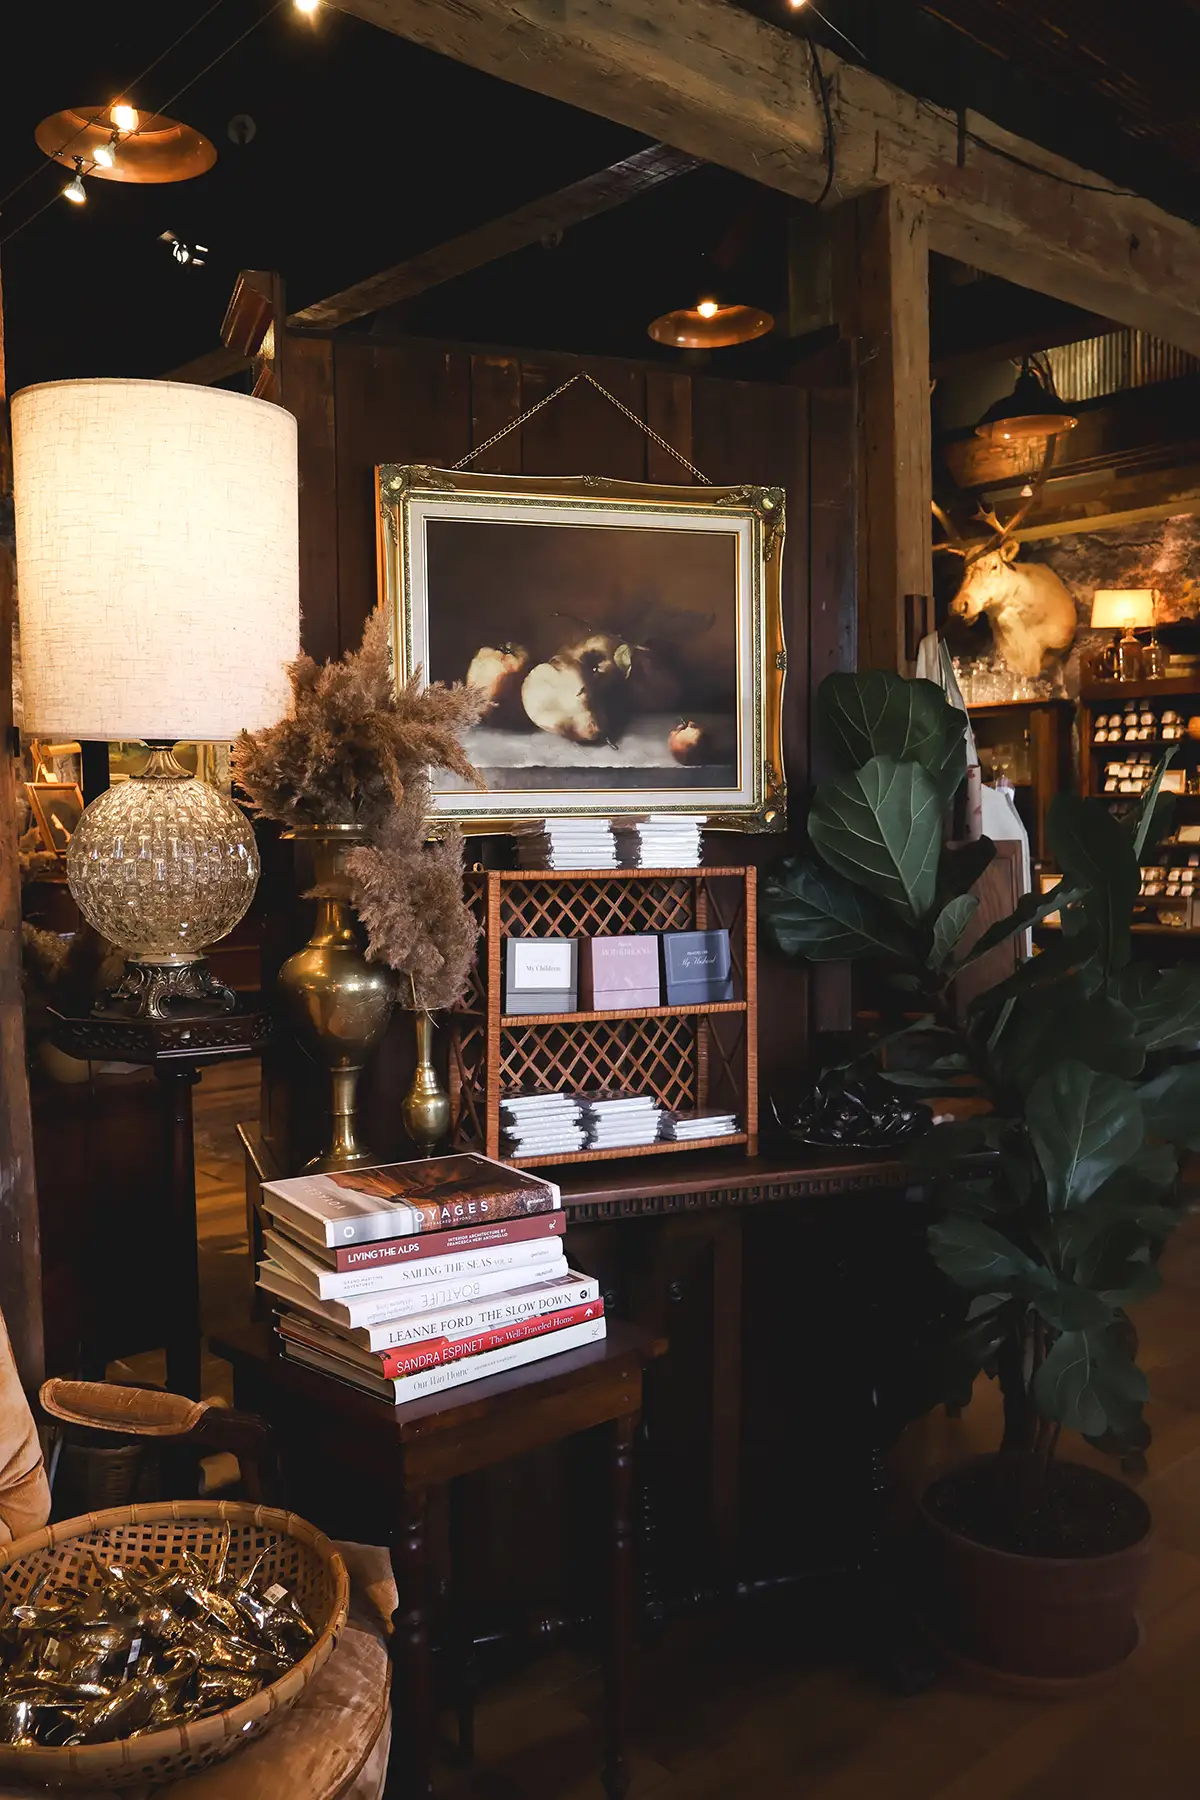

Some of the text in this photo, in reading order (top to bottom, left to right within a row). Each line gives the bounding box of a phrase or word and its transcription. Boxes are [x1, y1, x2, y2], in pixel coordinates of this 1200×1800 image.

[414, 1201, 489, 1222] OYAGES
[348, 1243, 420, 1263] LIVING THE ALPS
[402, 1266, 442, 1281] SAILING
[444, 1261, 465, 1273] THE
[466, 1257, 492, 1270] SEAS
[421, 1281, 480, 1309] BOATLIFE
[388, 1323, 438, 1344] LEANNE
[440, 1315, 474, 1332] FORD
[478, 1308, 503, 1323] THE
[505, 1301, 537, 1315] SLOW
[538, 1293, 572, 1309] DOWN
[396, 1315, 575, 1374] SANDRA ESPINET The Well-Traveled Home
[413, 1367, 470, 1391] Our Way Home
